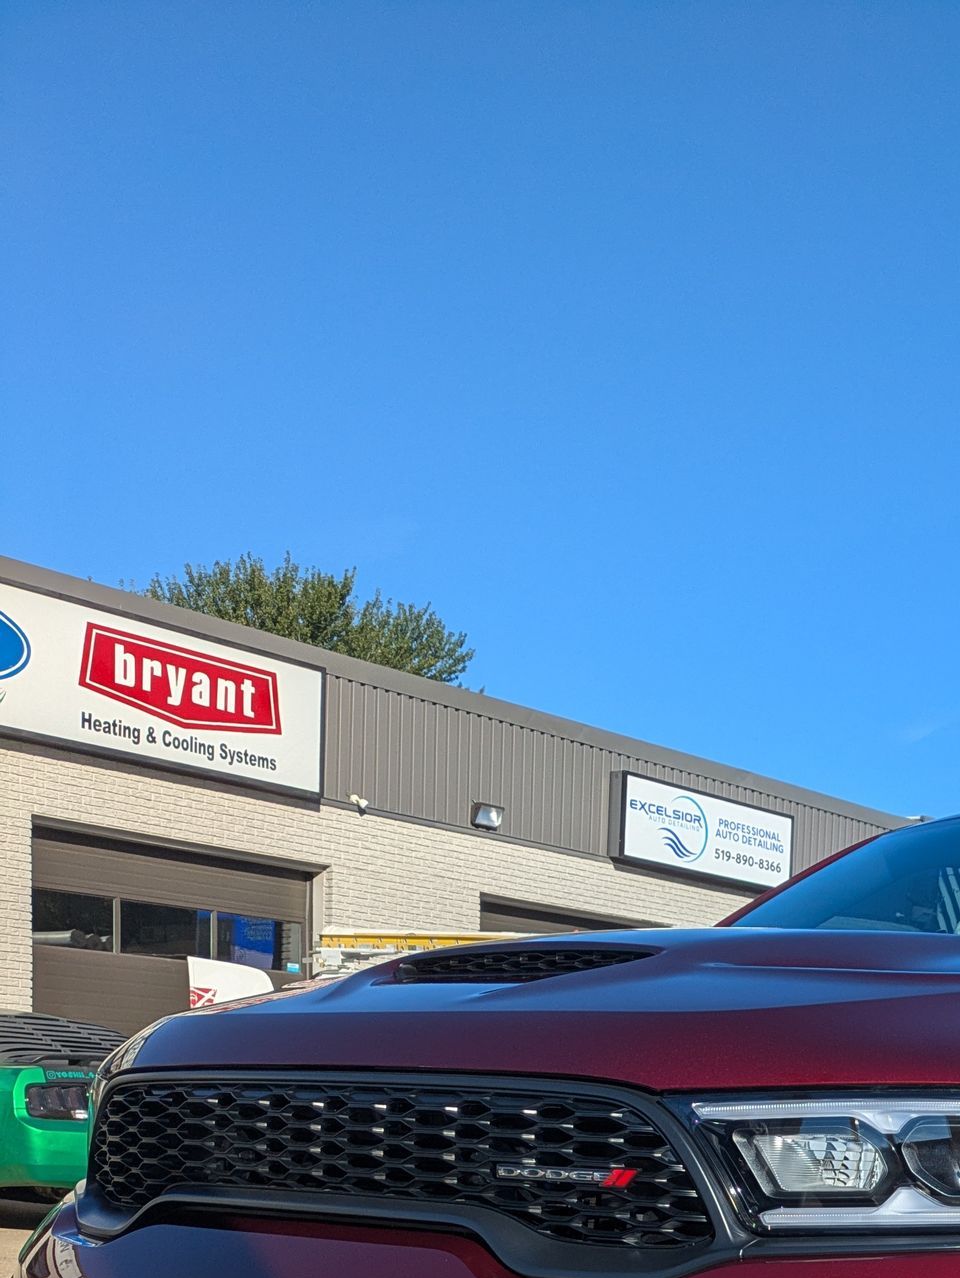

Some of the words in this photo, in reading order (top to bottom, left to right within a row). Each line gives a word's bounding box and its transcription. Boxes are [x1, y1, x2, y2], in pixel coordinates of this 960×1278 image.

[114, 643, 256, 718] bryant
[81, 711, 141, 745] Heating
[146, 726, 157, 744] &
[162, 730, 215, 761] Cooling
[219, 743, 277, 771] Systems
[629, 799, 703, 829] EXCELSIOR
[649, 815, 666, 824] AUTO
[668, 820, 700, 832] DETAILING
[715, 828, 740, 842] AUTO
[741, 836, 784, 854] DETAILING
[718, 818, 781, 843] PROFESSIONAL
[714, 848, 782, 873] 519-890-8366
[498, 1166, 610, 1182] DODGE
